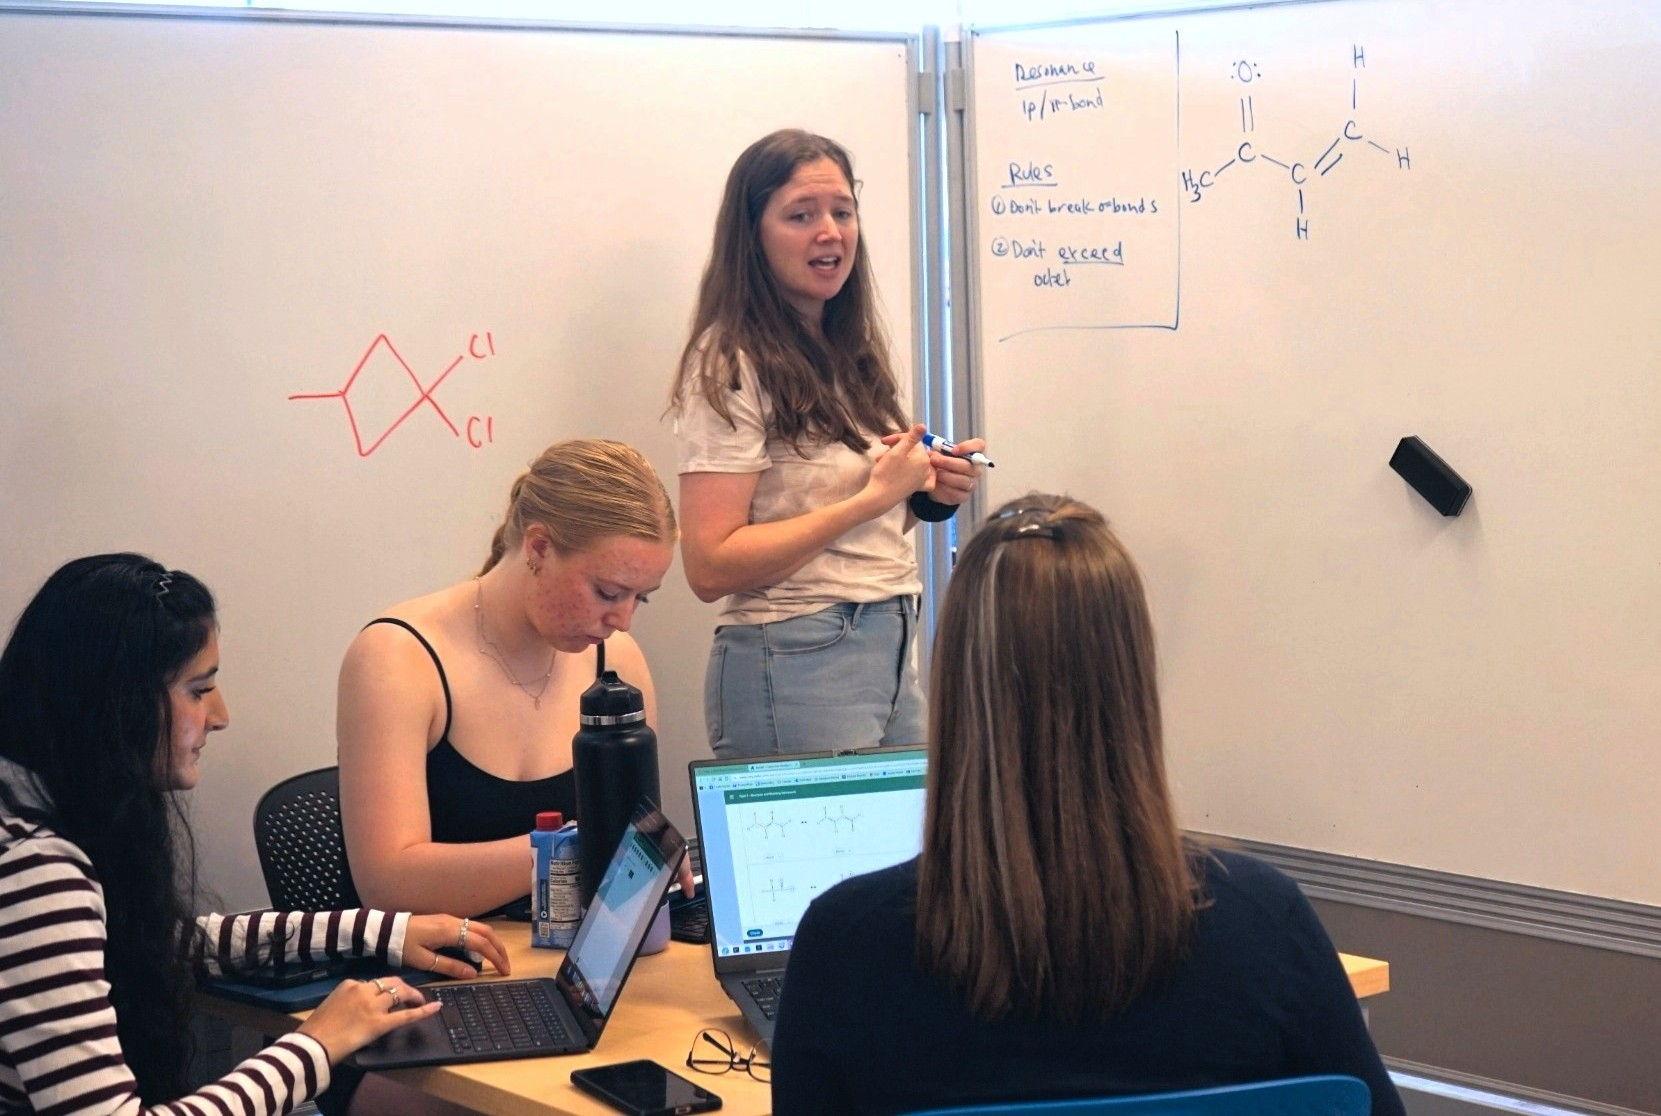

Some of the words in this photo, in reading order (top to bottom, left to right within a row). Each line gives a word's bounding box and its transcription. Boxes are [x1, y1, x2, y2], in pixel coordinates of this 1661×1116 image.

[1353, 44, 1366, 68] H
[1344, 120, 1363, 140] C
[1238, 142, 1256, 162] C
[1396, 147, 1411, 170] H
[1009, 161, 1053, 185] Rules
[1291, 163, 1307, 184] C
[1048, 199, 1094, 214] break
[1296, 217, 1308, 240] H
[1012, 239, 1046, 259] Don't
[1058, 240, 1123, 261] exceed
